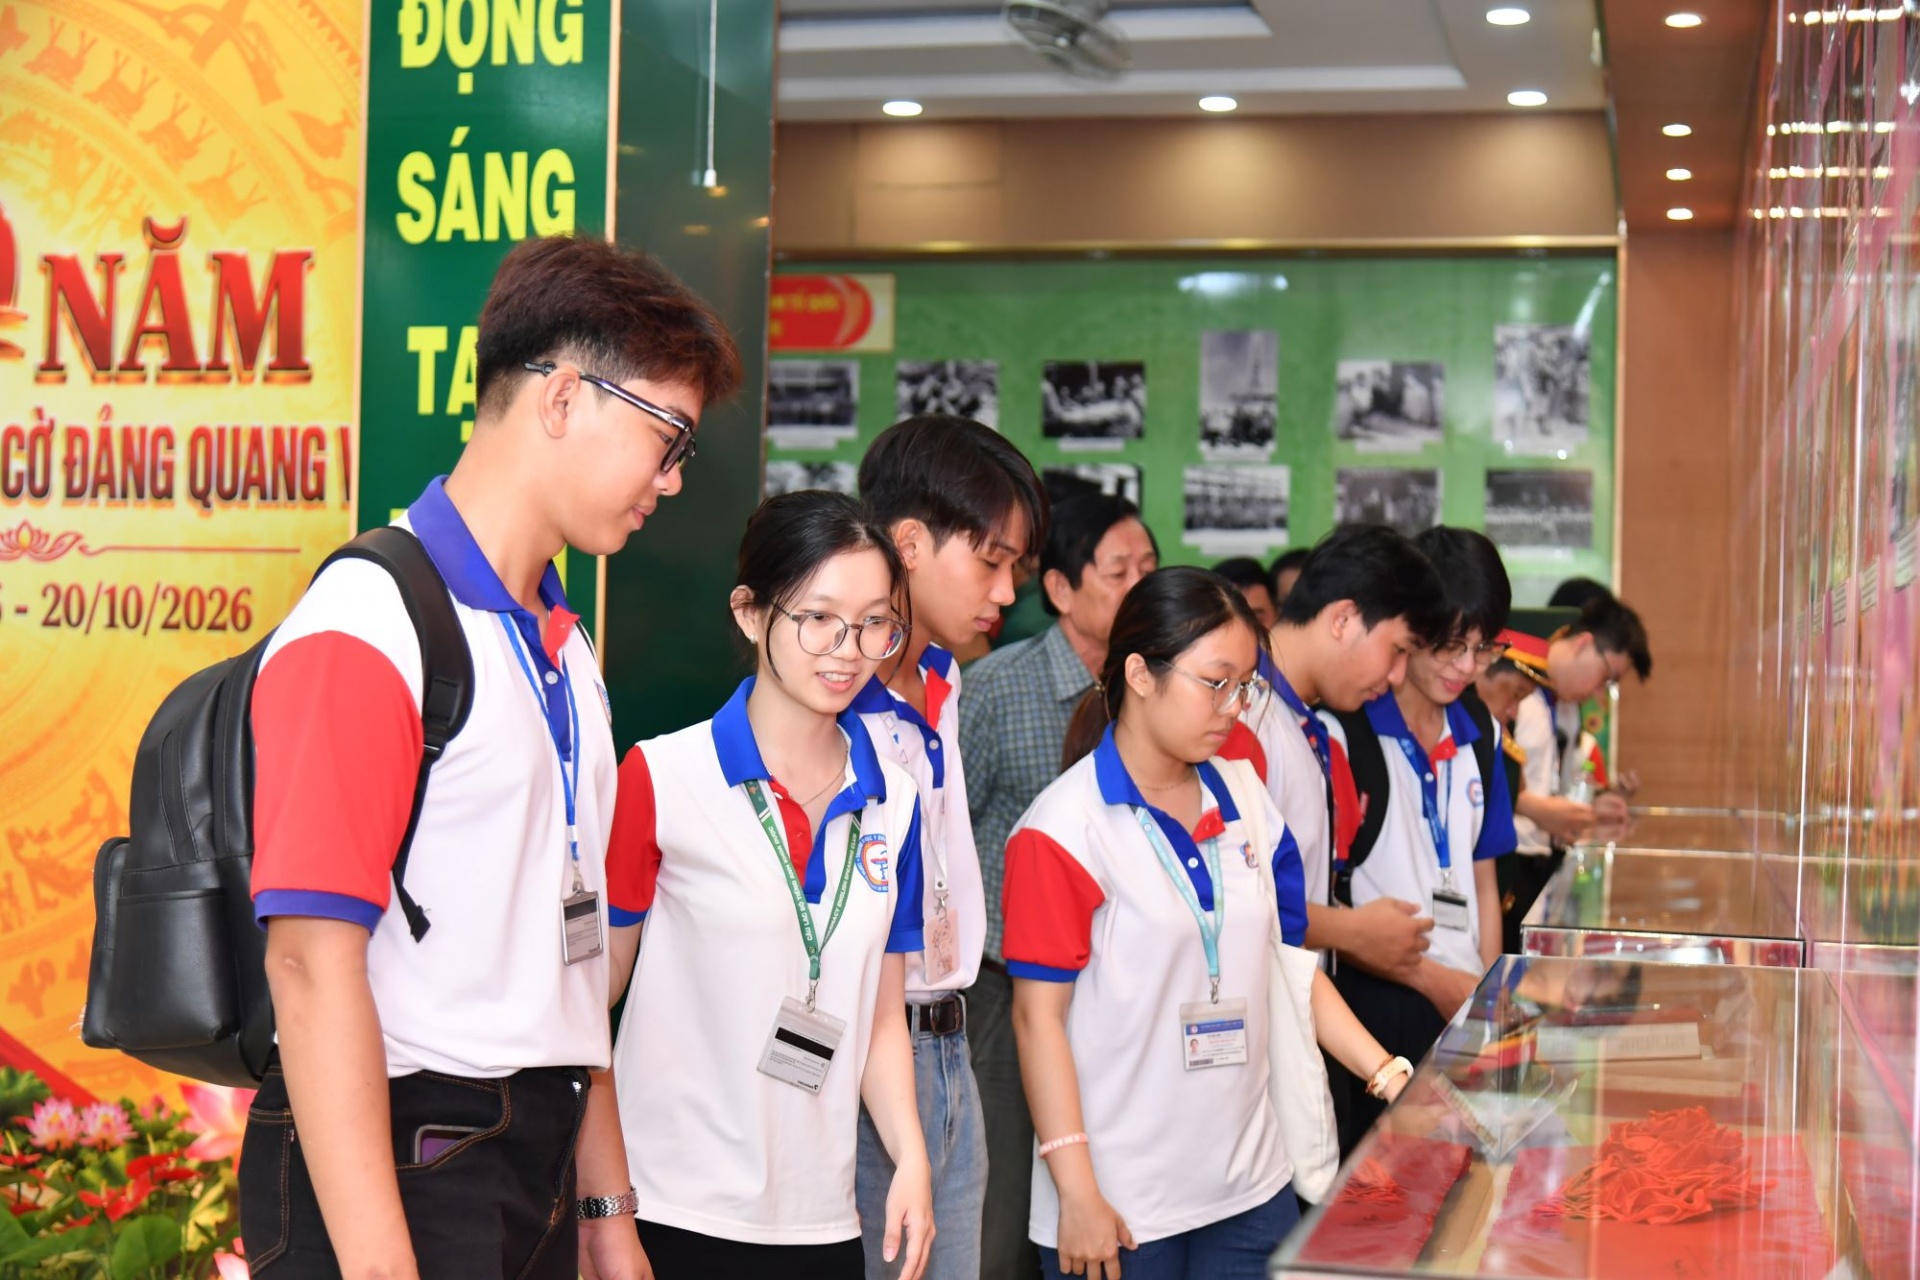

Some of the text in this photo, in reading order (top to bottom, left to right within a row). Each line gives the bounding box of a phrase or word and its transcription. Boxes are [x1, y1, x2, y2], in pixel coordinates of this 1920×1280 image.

[396, 126, 576, 244] SÁNG
[37, 214, 314, 385] NĂM
[407, 325, 478, 443] TẠ
[1, 406, 54, 499] CỜ
[63, 403, 175, 501] ĐẢNG
[188, 424, 327, 510] QUANG
[41, 580, 253, 636] 20/10/2026
[785, 863, 795, 879] ANH
